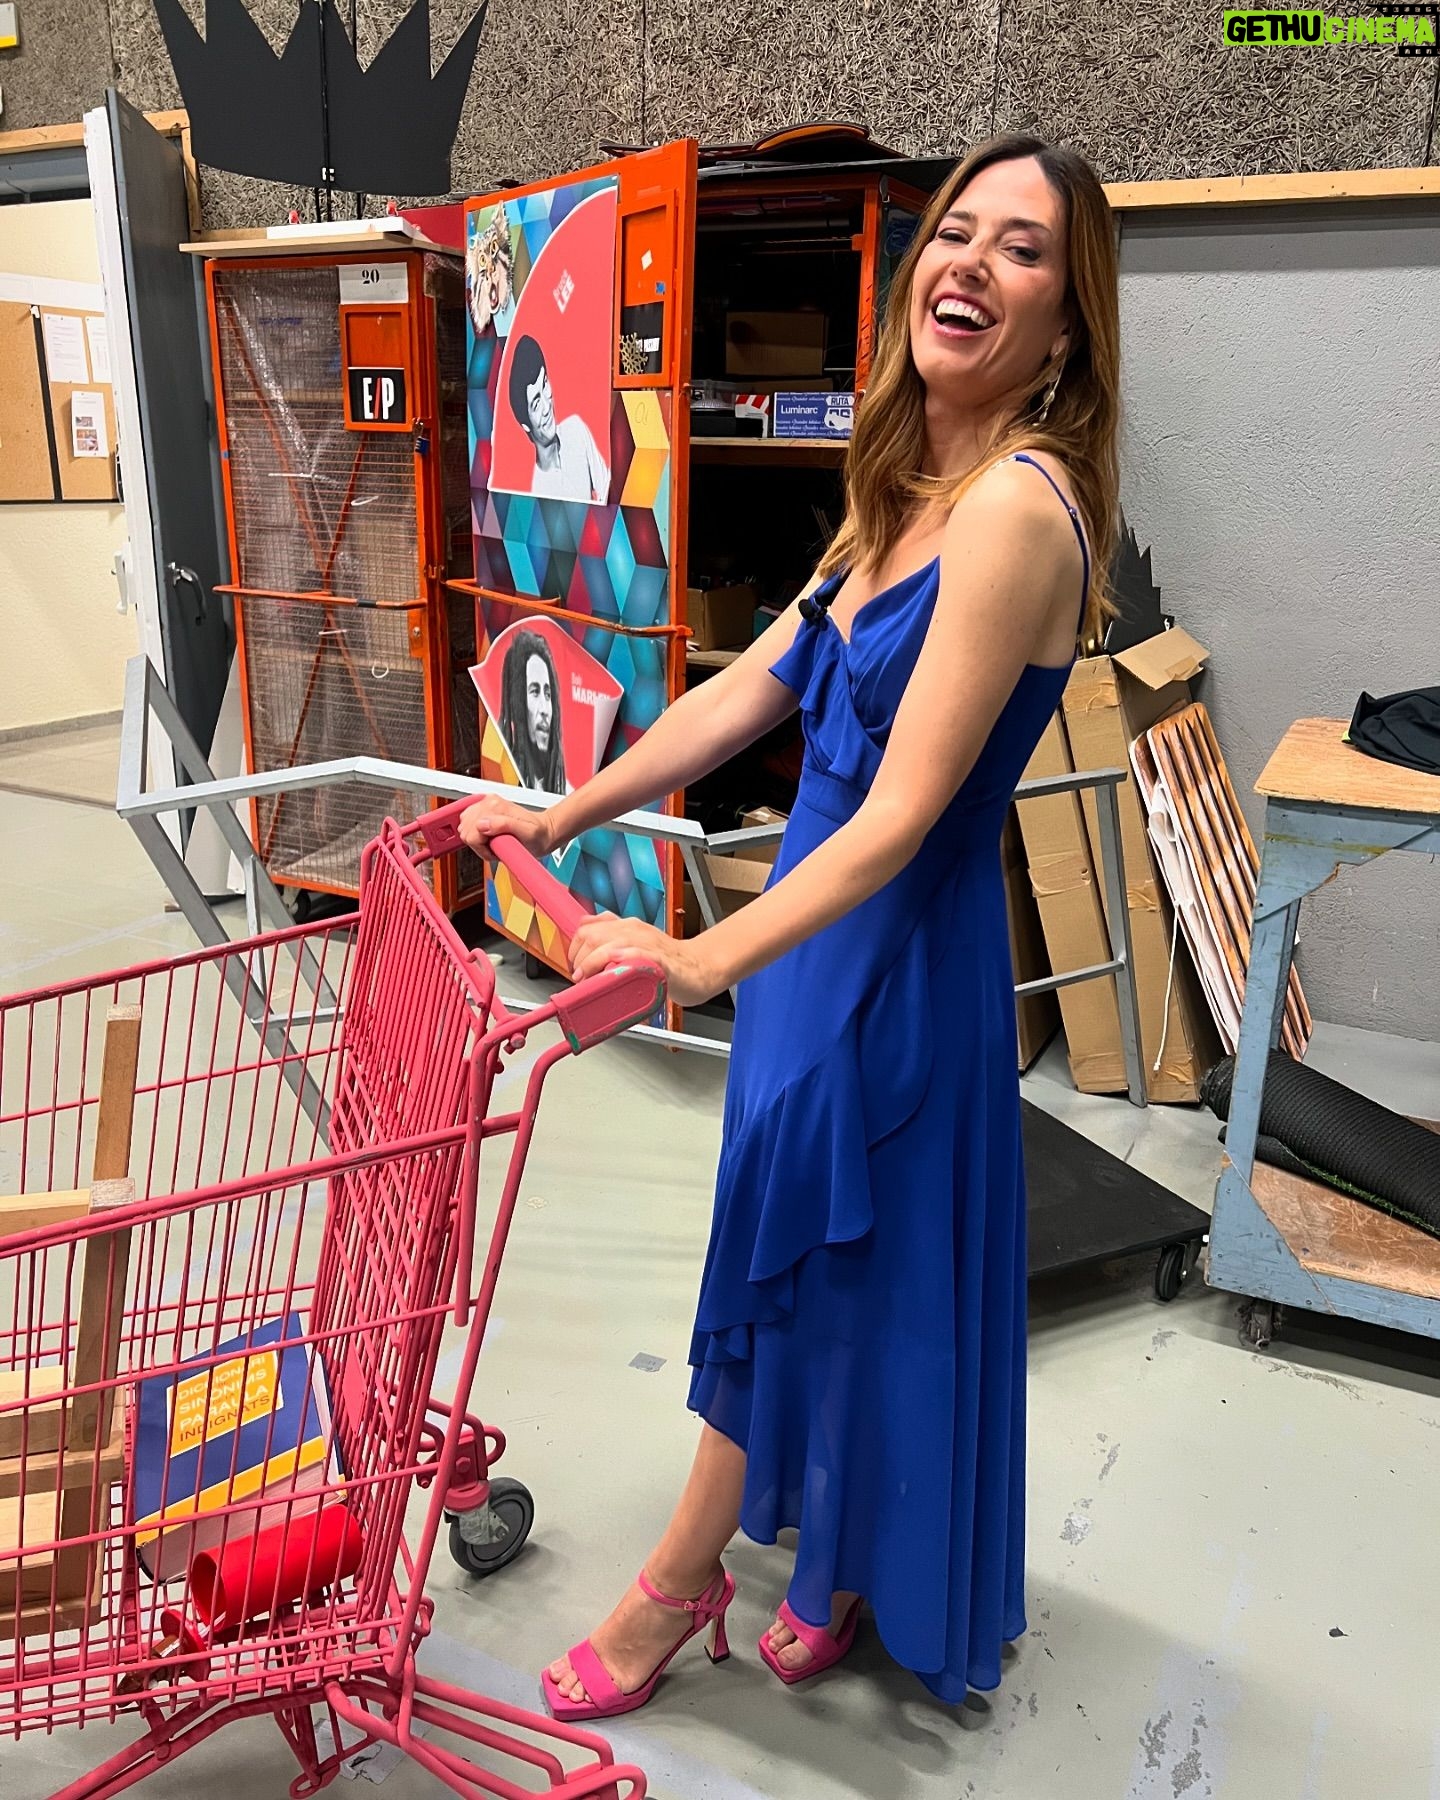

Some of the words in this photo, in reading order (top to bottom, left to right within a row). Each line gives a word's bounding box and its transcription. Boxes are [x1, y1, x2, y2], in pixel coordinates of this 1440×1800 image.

[361, 269, 380, 285] 20
[830, 397, 849, 406] RUTA
[780, 404, 818, 415] Luminarc
[178, 1355, 265, 1400] DICIONRI
